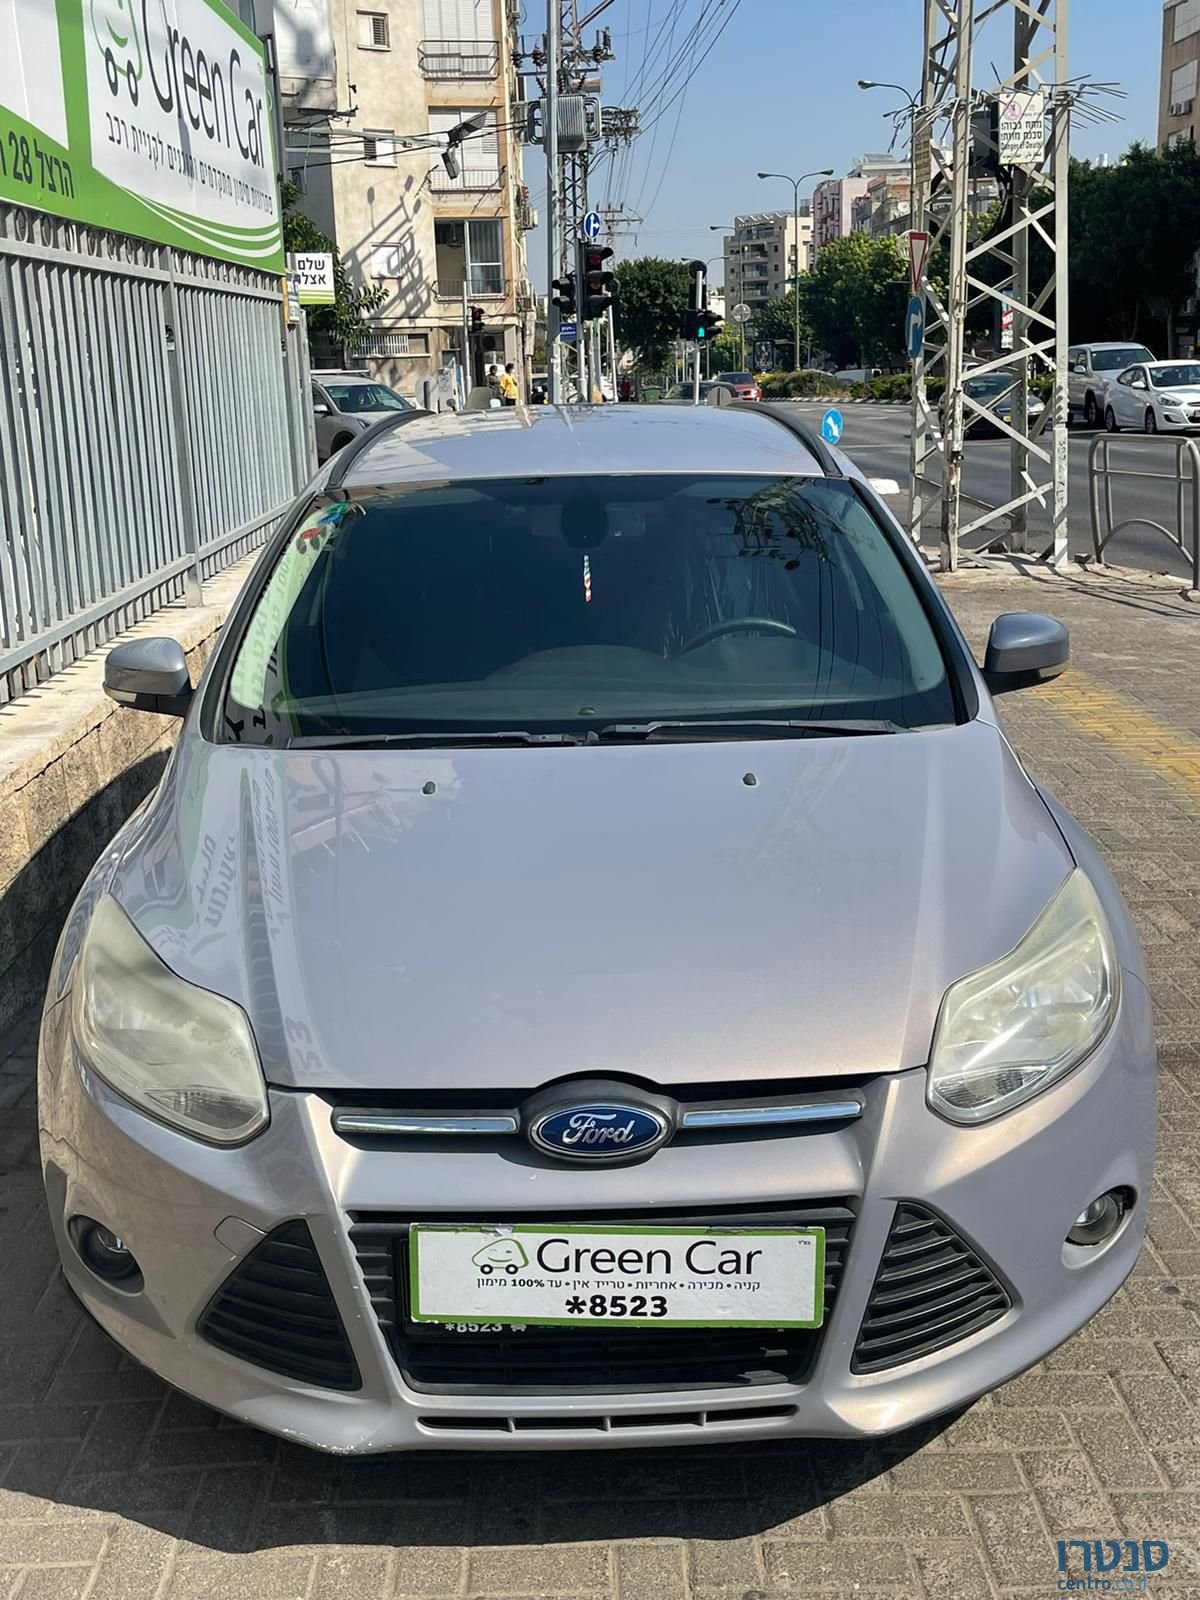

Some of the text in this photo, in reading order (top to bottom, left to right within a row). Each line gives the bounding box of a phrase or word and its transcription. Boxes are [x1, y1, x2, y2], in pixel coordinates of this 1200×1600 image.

[142, 0, 265, 169] Green Car
[105, 112, 130, 149] רכב
[130, 124, 164, 171] לקניית
[8, 130, 33, 185] 28
[33, 138, 75, 200] הרצל
[199, 161, 233, 199] מתקדמים
[297, 257, 325, 271] שלם
[562, 1113, 634, 1145] Ford
[536, 1238, 762, 1275] Green Car
[477, 1278, 760, 1291] קניה מכירה אחריות טרייד אין עד 100% מימון
